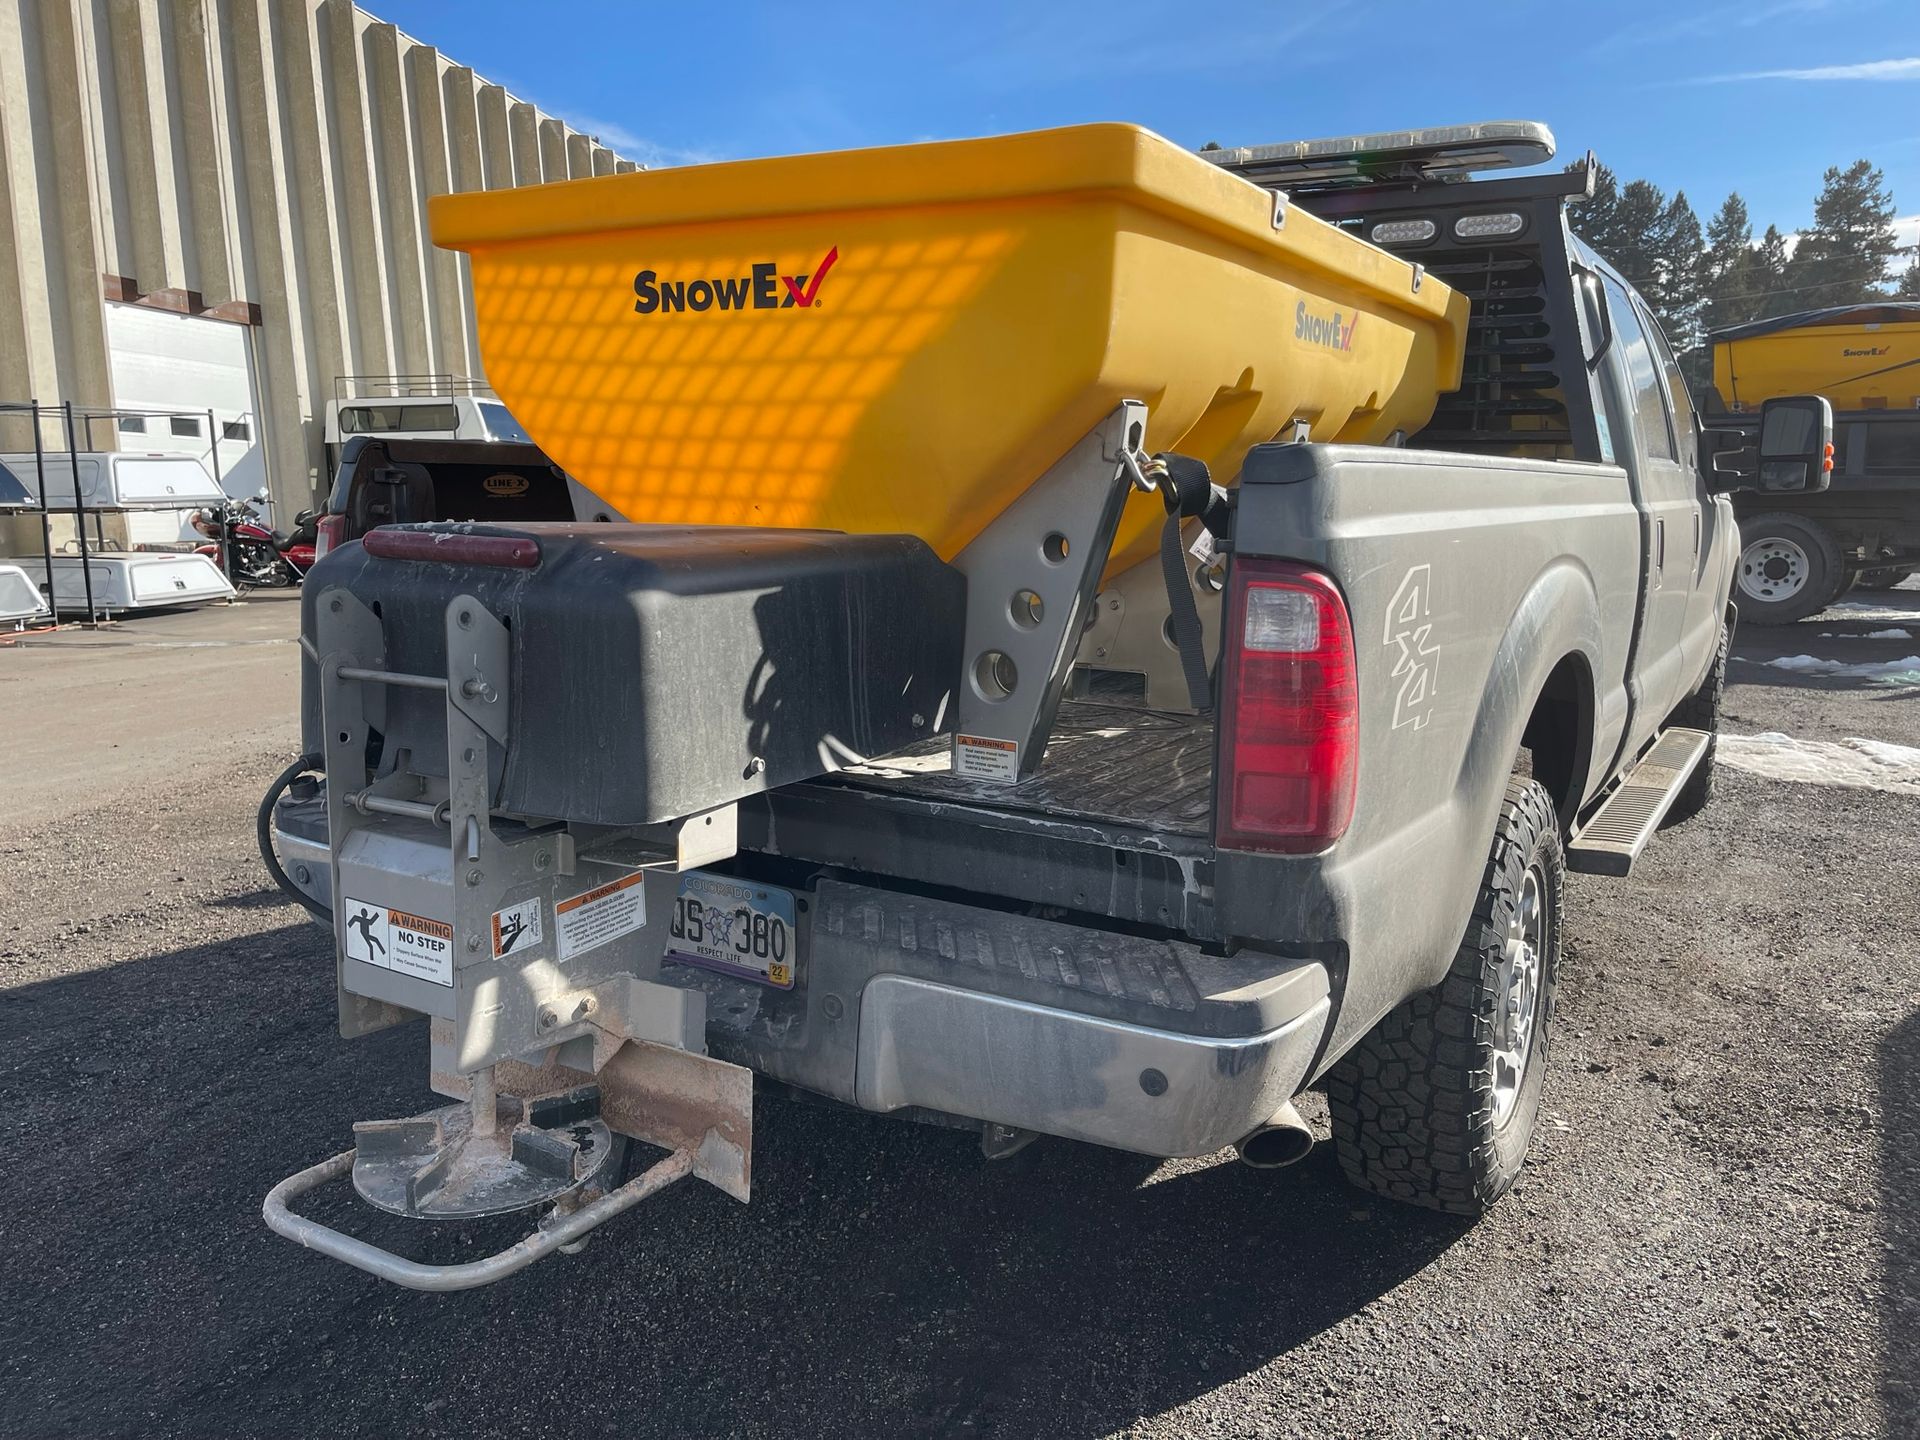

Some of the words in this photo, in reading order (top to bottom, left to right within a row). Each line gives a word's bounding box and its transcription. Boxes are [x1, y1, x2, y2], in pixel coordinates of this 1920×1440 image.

[972, 739, 1005, 749] WARNING
[590, 883, 620, 901] WARNING
[684, 877, 753, 900] COLORADO
[402, 915, 450, 938] WARNING
[735, 909, 786, 963] 380
[399, 930, 414, 945] NO
[418, 936, 446, 954] STEP
[697, 946, 723, 958] RESPECT
[726, 953, 742, 963] LIFE
[770, 965, 783, 977] 22
